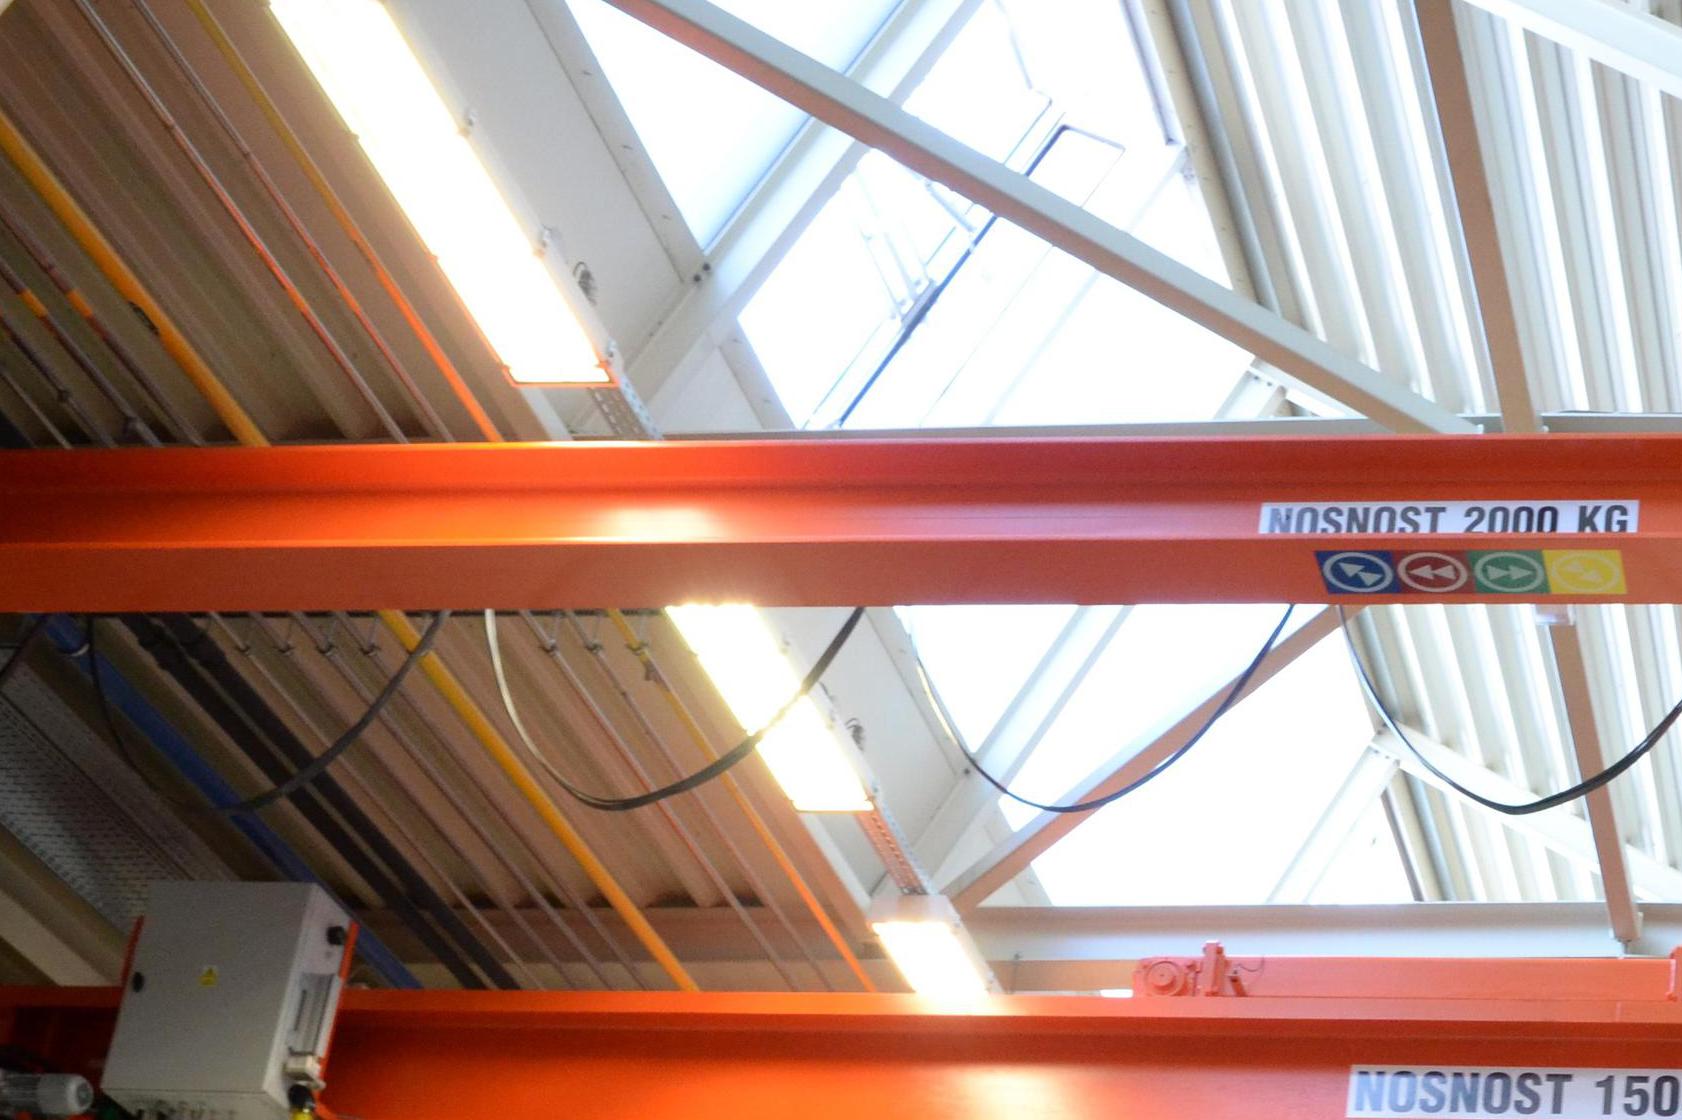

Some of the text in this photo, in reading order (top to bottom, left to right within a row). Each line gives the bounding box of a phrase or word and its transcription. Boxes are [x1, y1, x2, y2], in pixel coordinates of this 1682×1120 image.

[1268, 504, 1629, 533] NOSNOST 2000 KG
[1353, 1070, 1573, 1116] NOSNOST
